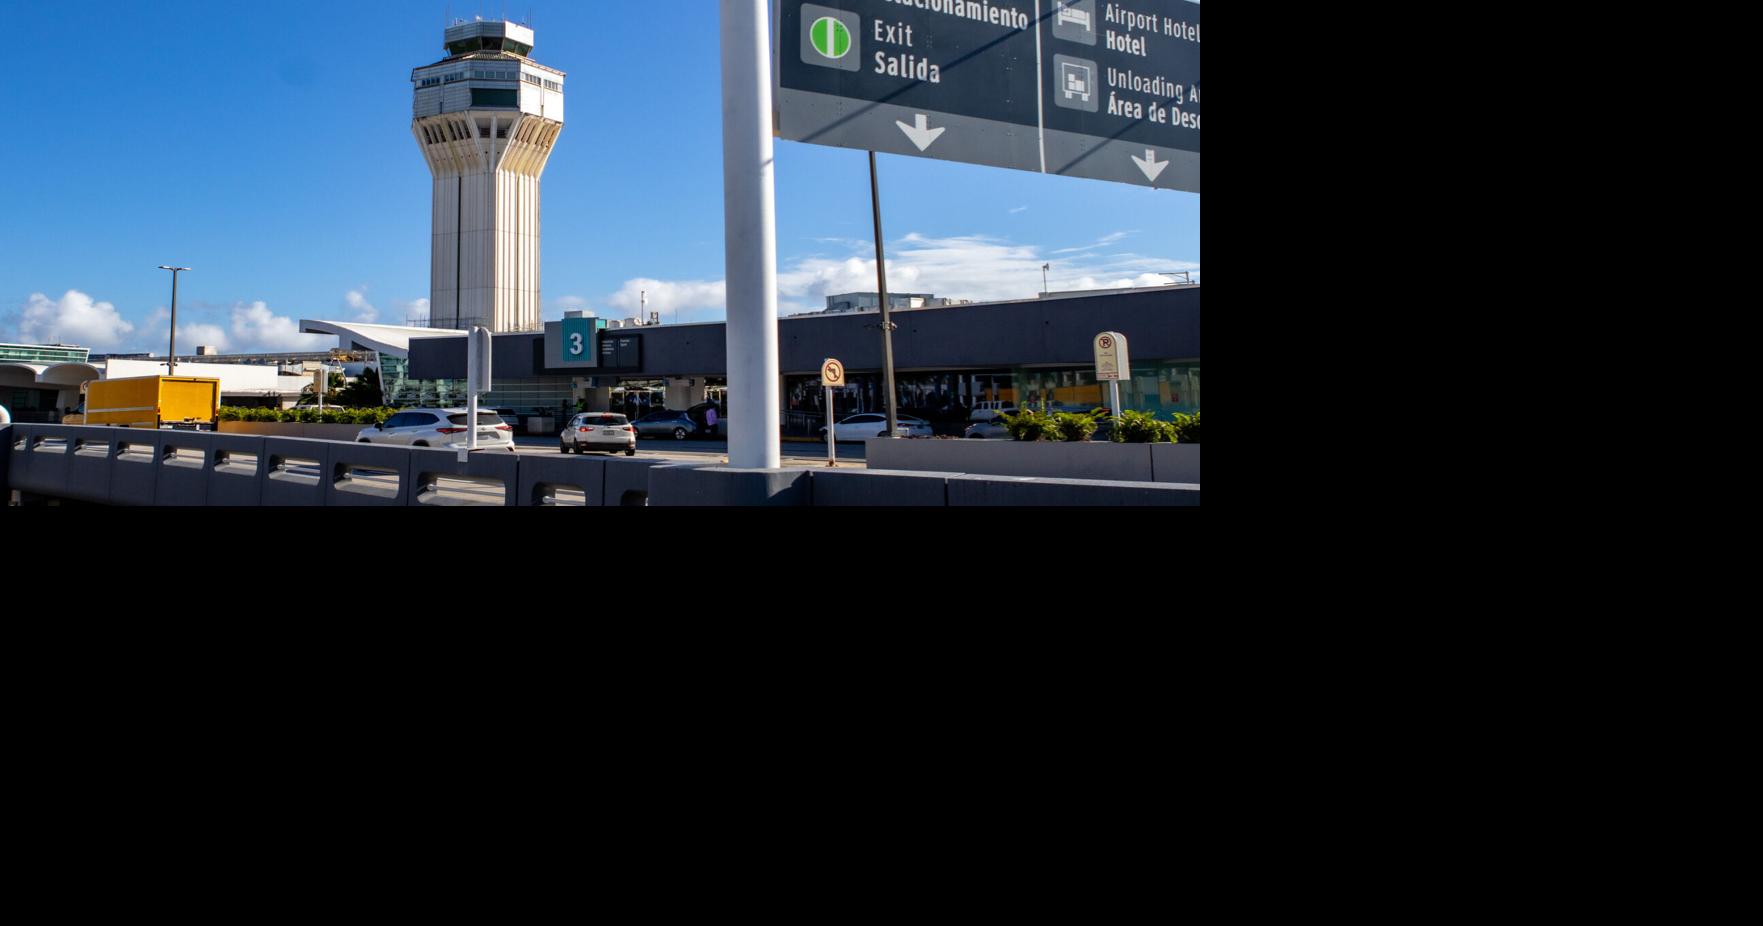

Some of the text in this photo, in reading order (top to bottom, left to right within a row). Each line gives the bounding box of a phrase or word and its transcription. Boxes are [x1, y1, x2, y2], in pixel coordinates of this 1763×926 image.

[884, 0, 1028, 30] onamiento
[1105, 3, 1200, 43] Airport Hotel
[874, 19, 913, 47] Exit
[1106, 30, 1147, 57] Hotel
[874, 50, 940, 83] Salida
[1107, 67, 1200, 104] Unloading A
[1107, 91, 1142, 119] Área
[1148, 102, 1166, 123] de
[569, 332, 583, 355] 3
